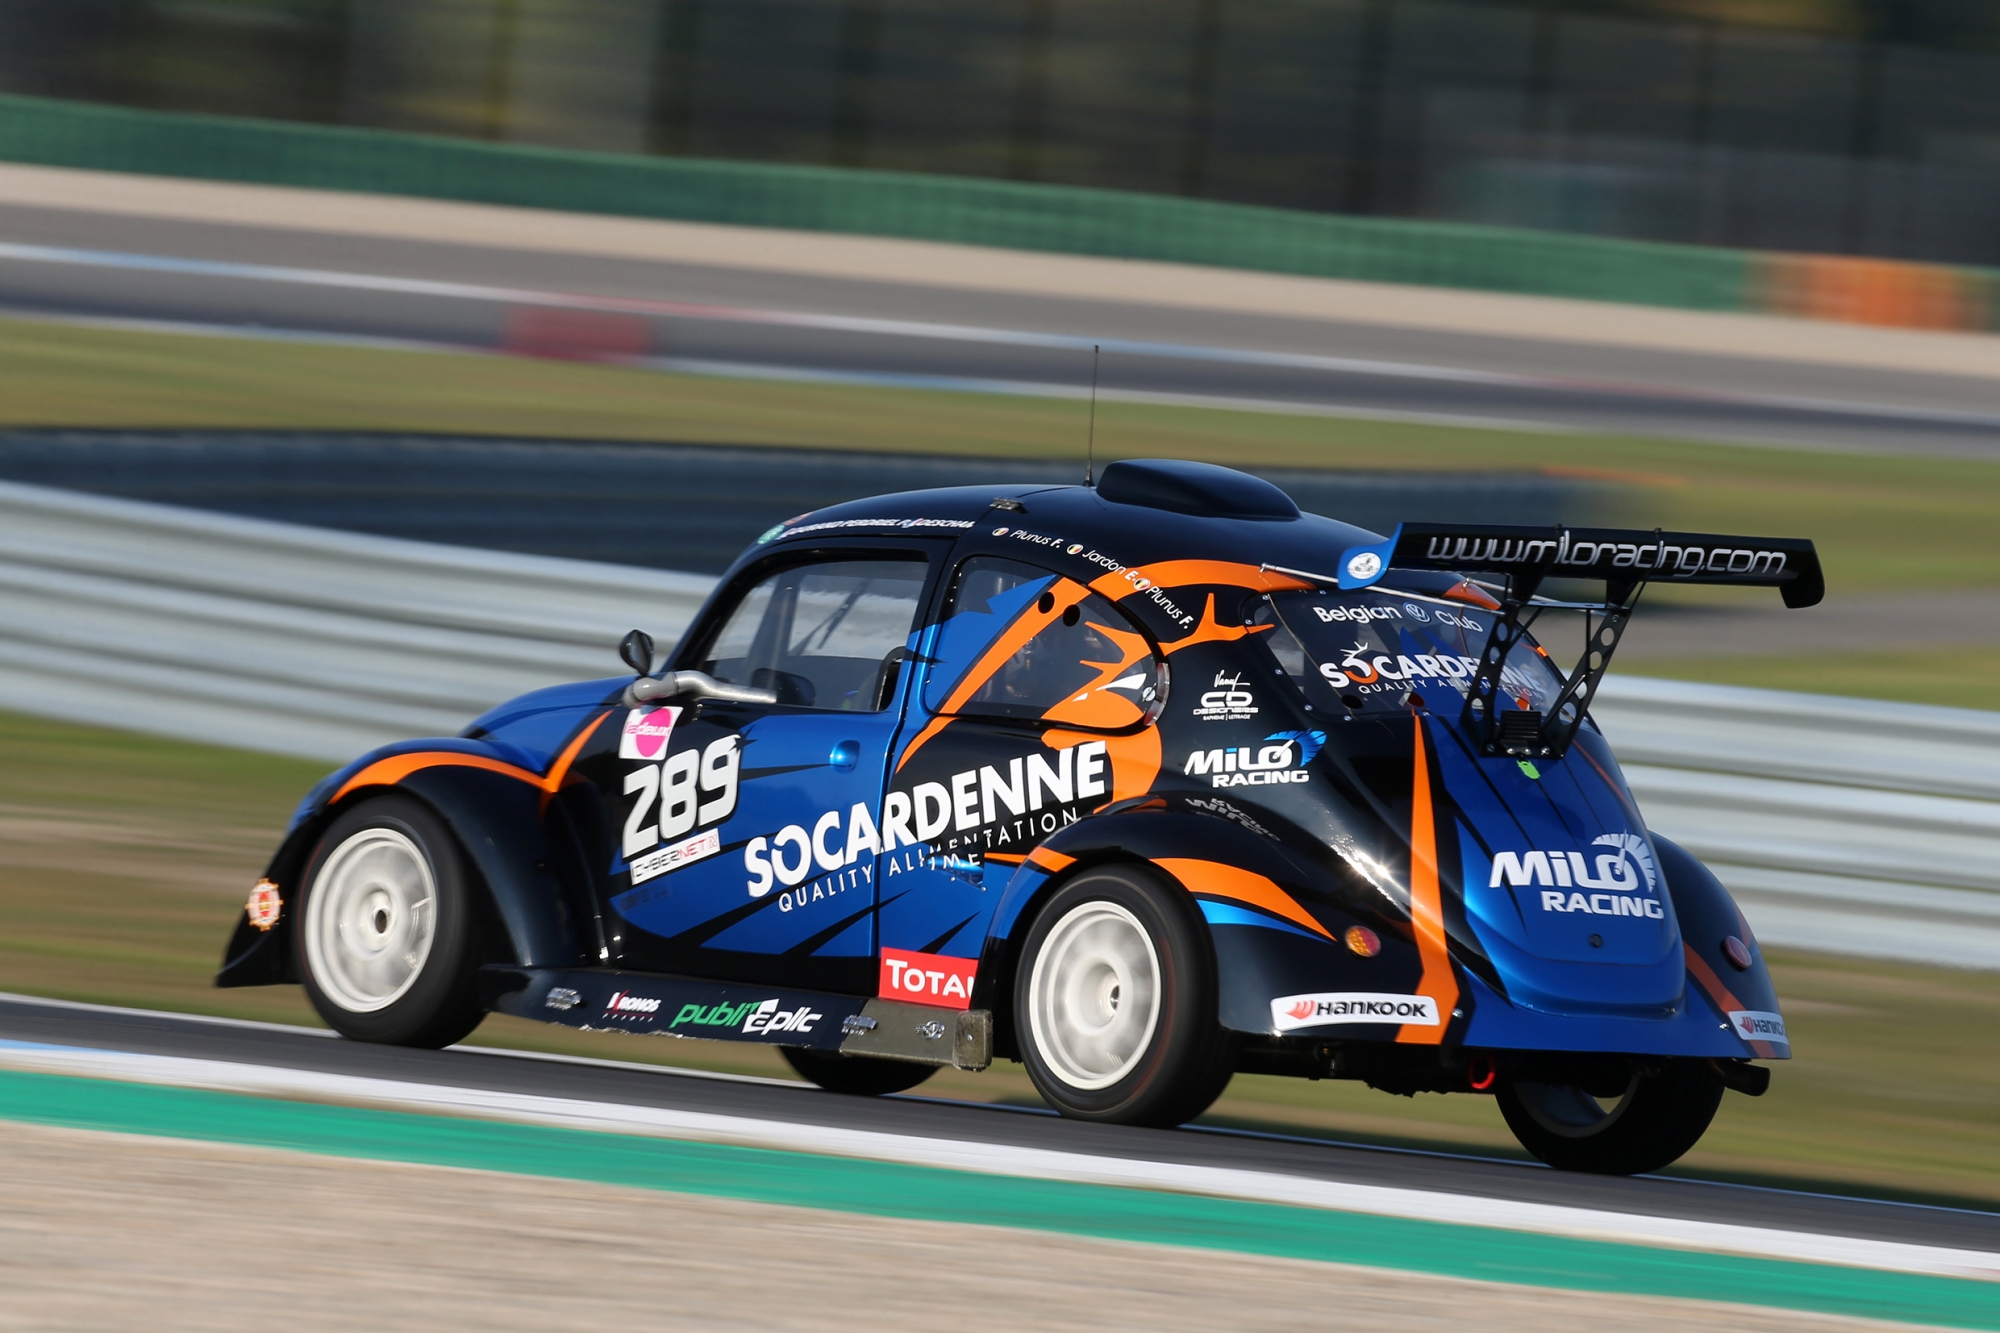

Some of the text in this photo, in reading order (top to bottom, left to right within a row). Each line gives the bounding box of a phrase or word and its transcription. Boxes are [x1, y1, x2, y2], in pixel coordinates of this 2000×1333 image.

[1010, 529, 1061, 549] Plunus F.
[1082, 549, 1126, 575] Jardon
[1427, 530, 1787, 577] www.miloracing.com
[1145, 585, 1194, 630] Plunus F.
[1313, 606, 1402, 624] Belgian
[1434, 610, 1483, 632] Club
[1201, 691, 1253, 708] CD
[1358, 680, 1428, 695] QUALITY
[1193, 707, 1258, 715] DESIGNERS
[1212, 769, 1310, 788] RACING
[622, 734, 741, 859] 289
[744, 740, 1106, 898] SOCARDENNE
[778, 864, 873, 913] QUALITY
[1540, 890, 1665, 919] RACING
